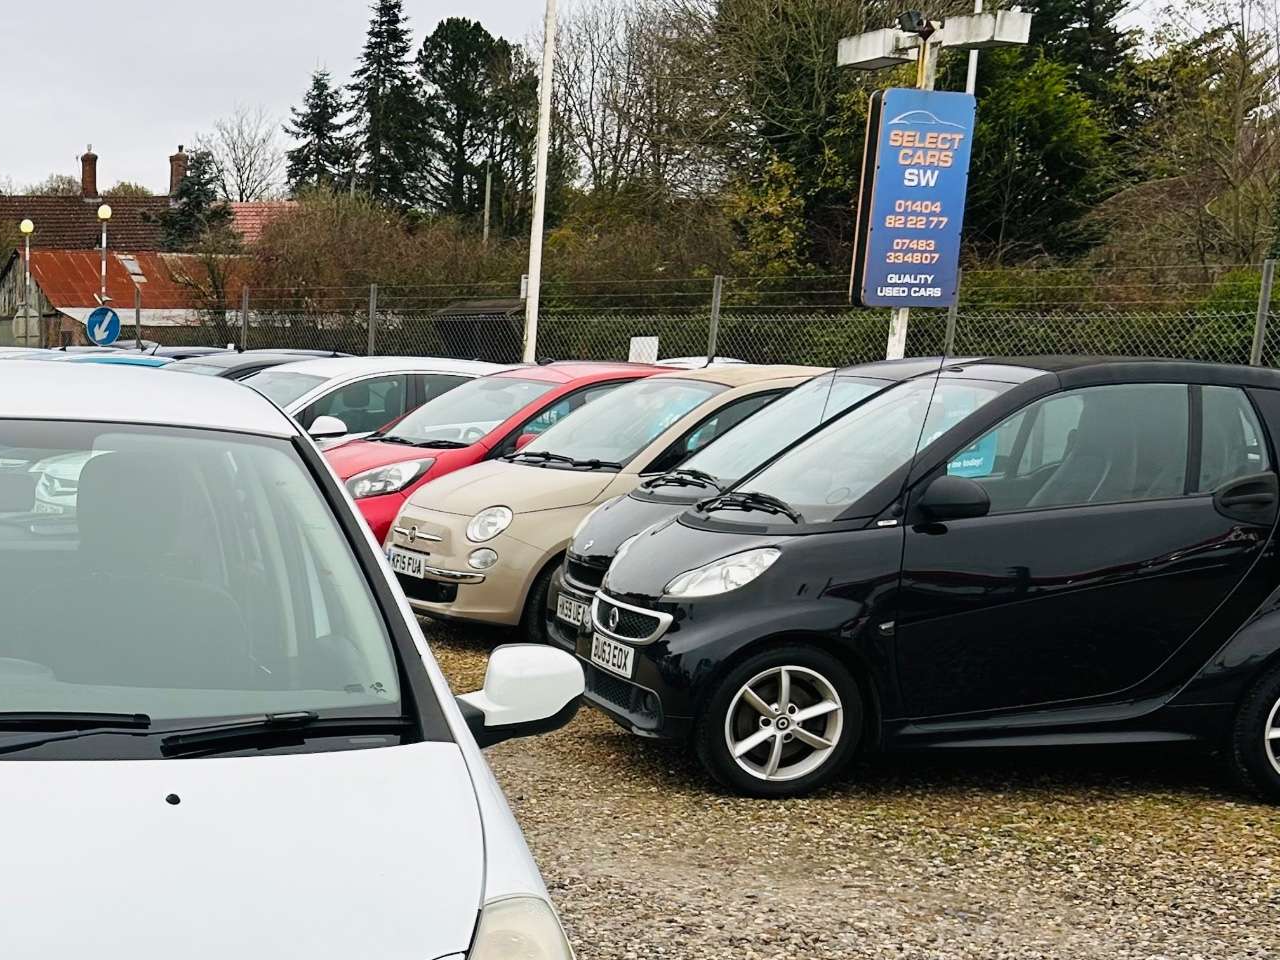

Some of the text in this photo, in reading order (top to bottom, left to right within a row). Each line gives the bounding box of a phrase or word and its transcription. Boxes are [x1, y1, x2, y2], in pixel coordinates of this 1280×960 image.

[888, 129, 964, 151] SELECT
[898, 148, 954, 168] CARS
[903, 168, 940, 188] SW
[894, 199, 942, 214] 01404
[893, 239, 936, 251] 07483
[885, 252, 940, 264] 334807
[886, 274, 935, 284] QUALITY
[876, 286, 942, 298] USED CARS
[406, 556, 422, 575] FUA
[593, 636, 612, 664] BU63
